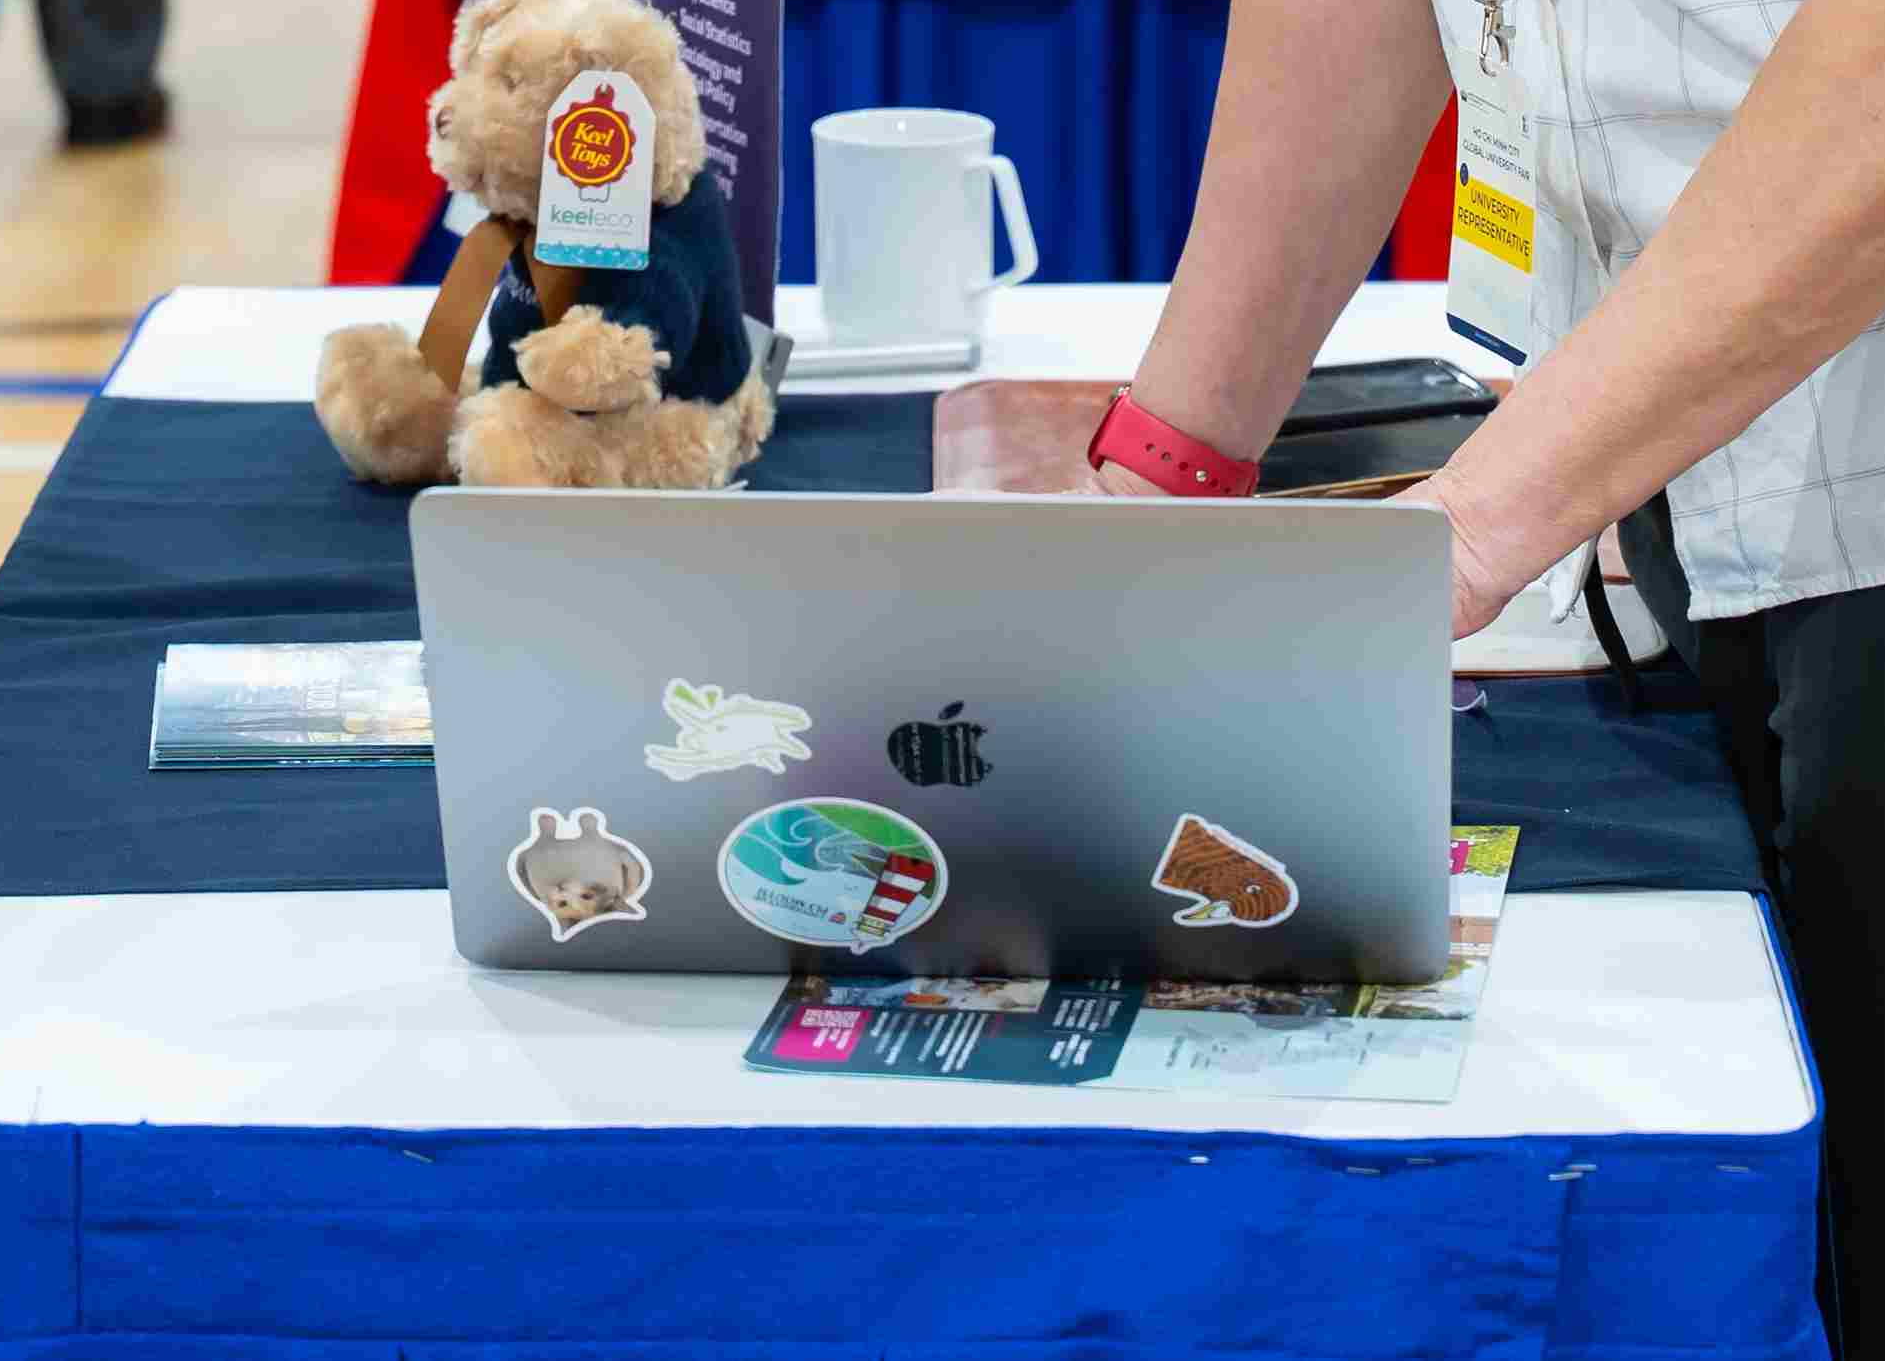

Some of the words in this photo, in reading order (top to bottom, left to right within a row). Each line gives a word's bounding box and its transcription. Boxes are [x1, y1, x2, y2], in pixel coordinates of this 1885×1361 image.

[573, 122, 616, 147] Keel
[569, 142, 612, 170] Toys
[549, 204, 634, 228] keeleco
[1469, 187, 1521, 225] UNIVERSITY
[1457, 205, 1532, 257] REPRESENTATIVE
